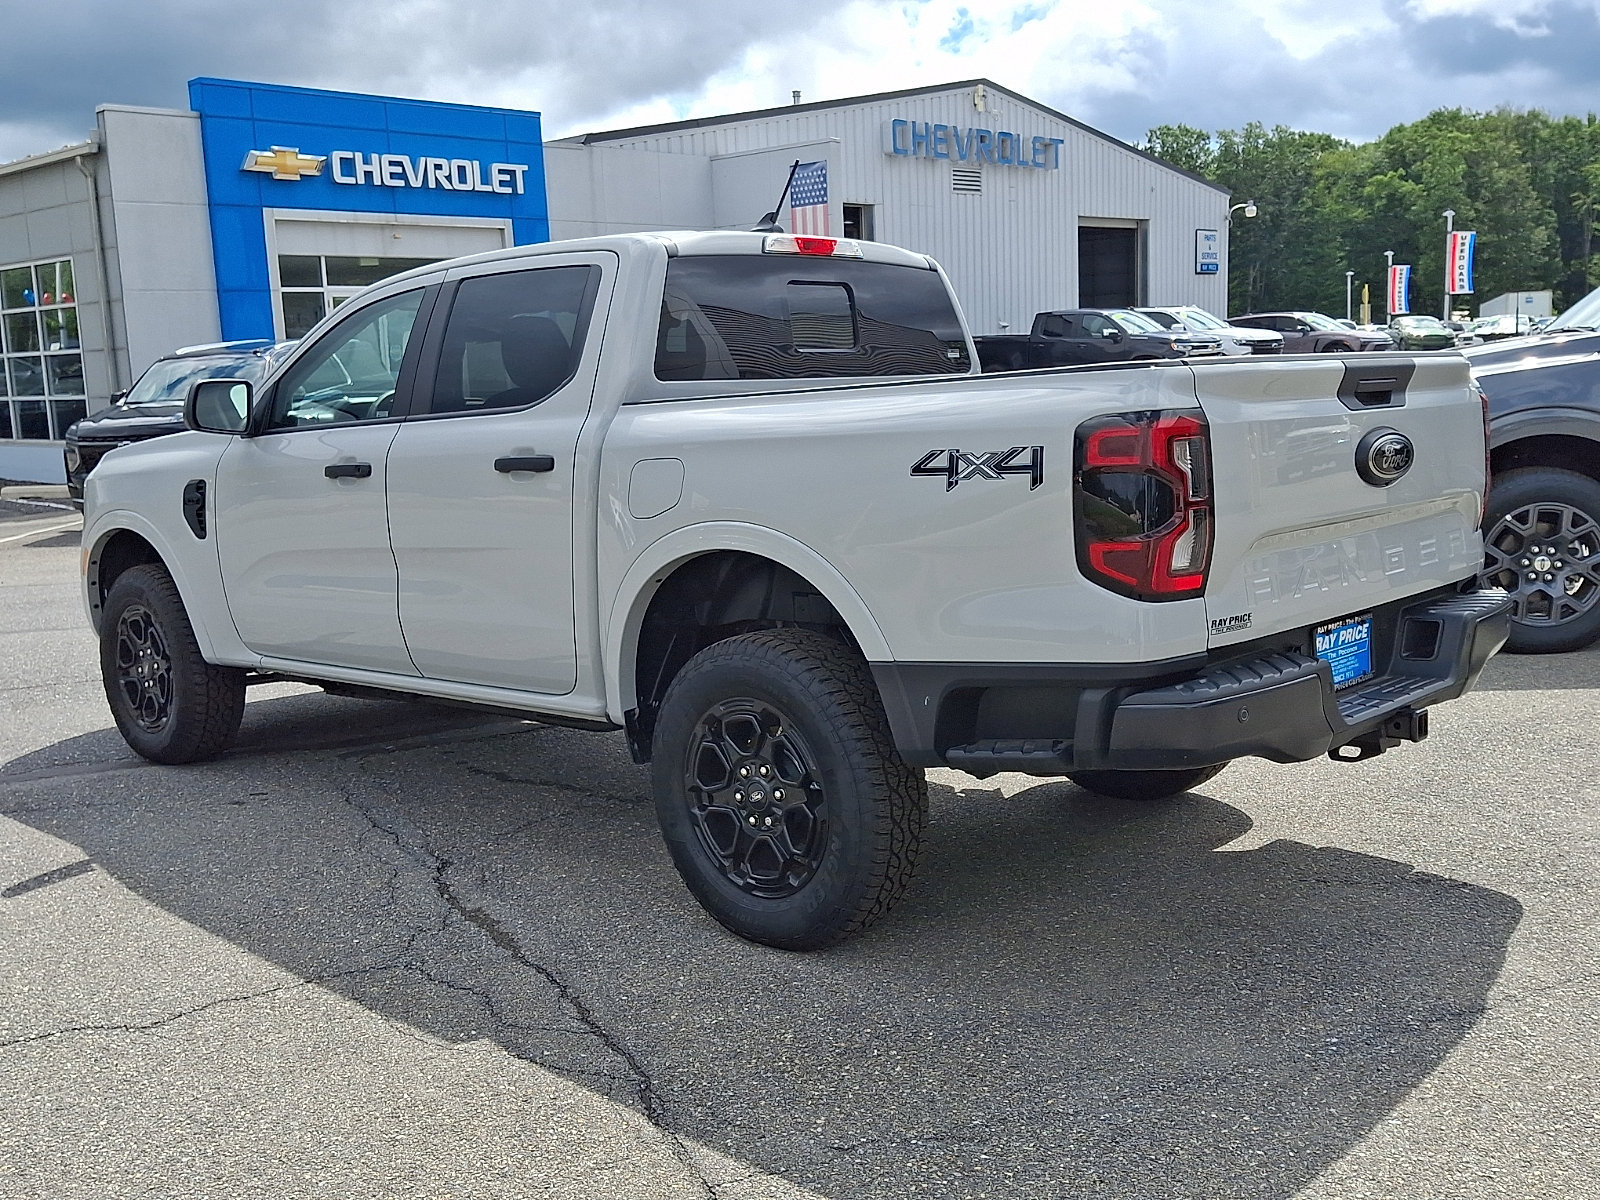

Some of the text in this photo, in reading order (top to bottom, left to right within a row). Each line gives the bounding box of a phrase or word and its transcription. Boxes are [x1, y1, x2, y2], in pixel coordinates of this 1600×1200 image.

[891, 119, 1064, 169] CHEVROLET
[332, 151, 528, 194] CHEVROLET
[1383, 443, 1408, 469] Ford
[1244, 528, 1468, 606] RANGER
[1211, 612, 1252, 629] RAY PRICE
[1317, 624, 1328, 635] RAY
[1328, 621, 1343, 631] PRICE
[1316, 623, 1369, 652] RAY PRICE
[1328, 645, 1358, 660] The Poconos
